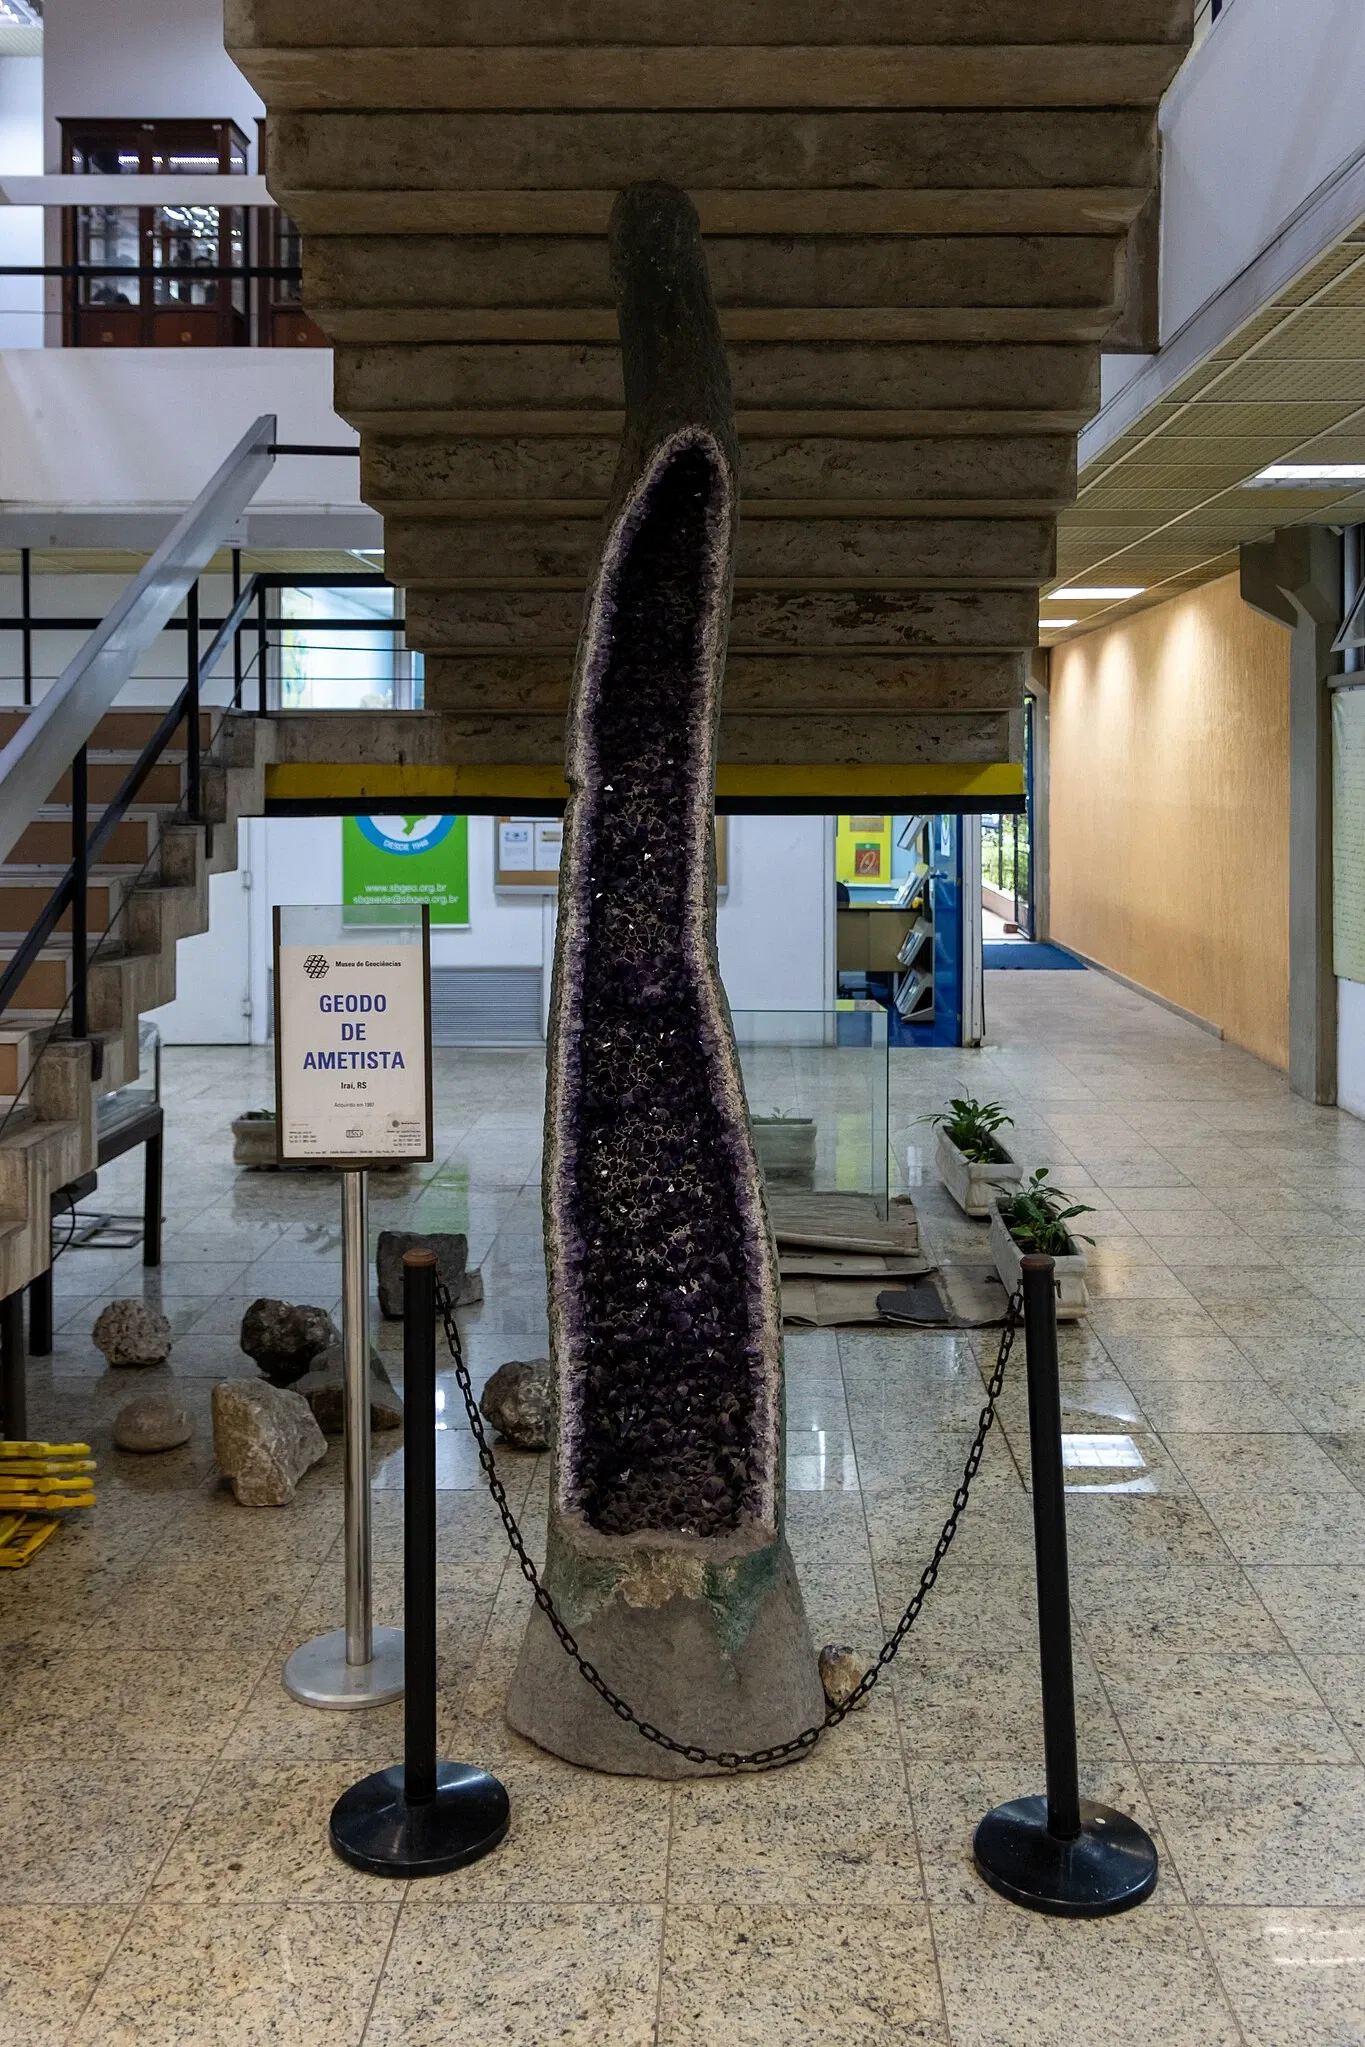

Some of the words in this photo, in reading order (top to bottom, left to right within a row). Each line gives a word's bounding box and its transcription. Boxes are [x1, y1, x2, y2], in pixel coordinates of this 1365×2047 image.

[364, 884, 447, 895] www.sbgeo.org.br
[319, 994, 387, 1013] GEODO
[341, 1023, 366, 1041] DE
[303, 1051, 405, 1069] AMETISTA
[357, 1081, 367, 1089] RS
